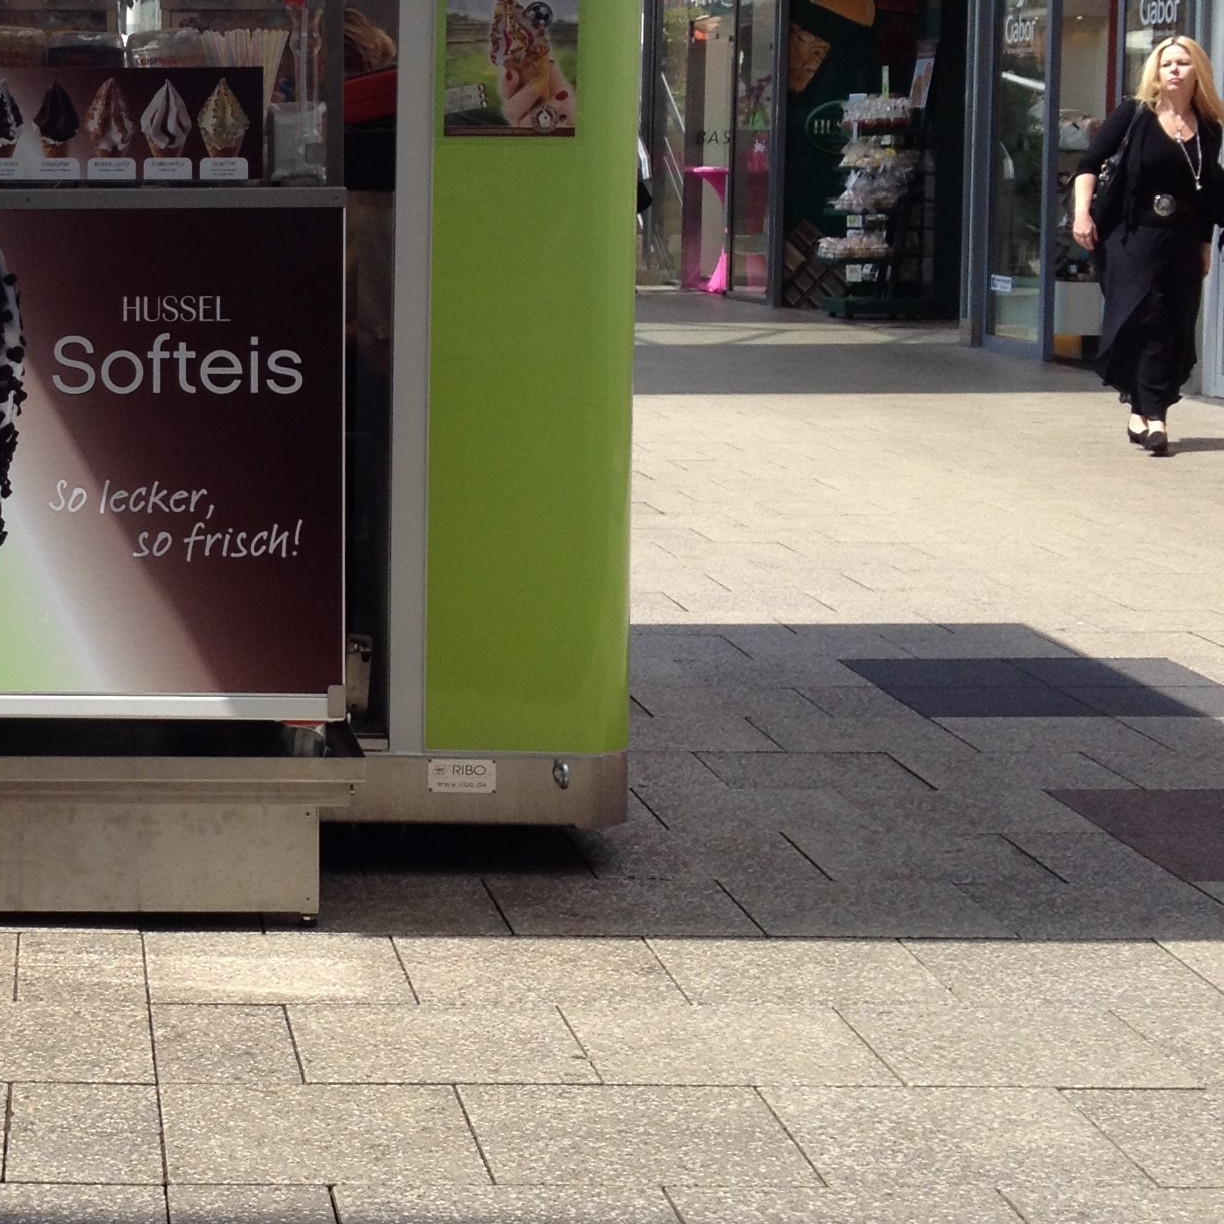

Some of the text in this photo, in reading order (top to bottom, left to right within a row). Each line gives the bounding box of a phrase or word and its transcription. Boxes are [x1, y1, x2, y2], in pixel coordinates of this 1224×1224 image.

[1005, 15, 1039, 44] Gabor
[695, 129, 732, 145] BAS
[122, 295, 231, 322] HUSSEL
[52, 332, 304, 395] Softeis
[48, 479, 215, 519] So lecker,
[132, 518, 303, 562] so frisch!
[452, 764, 487, 776] RIBO
